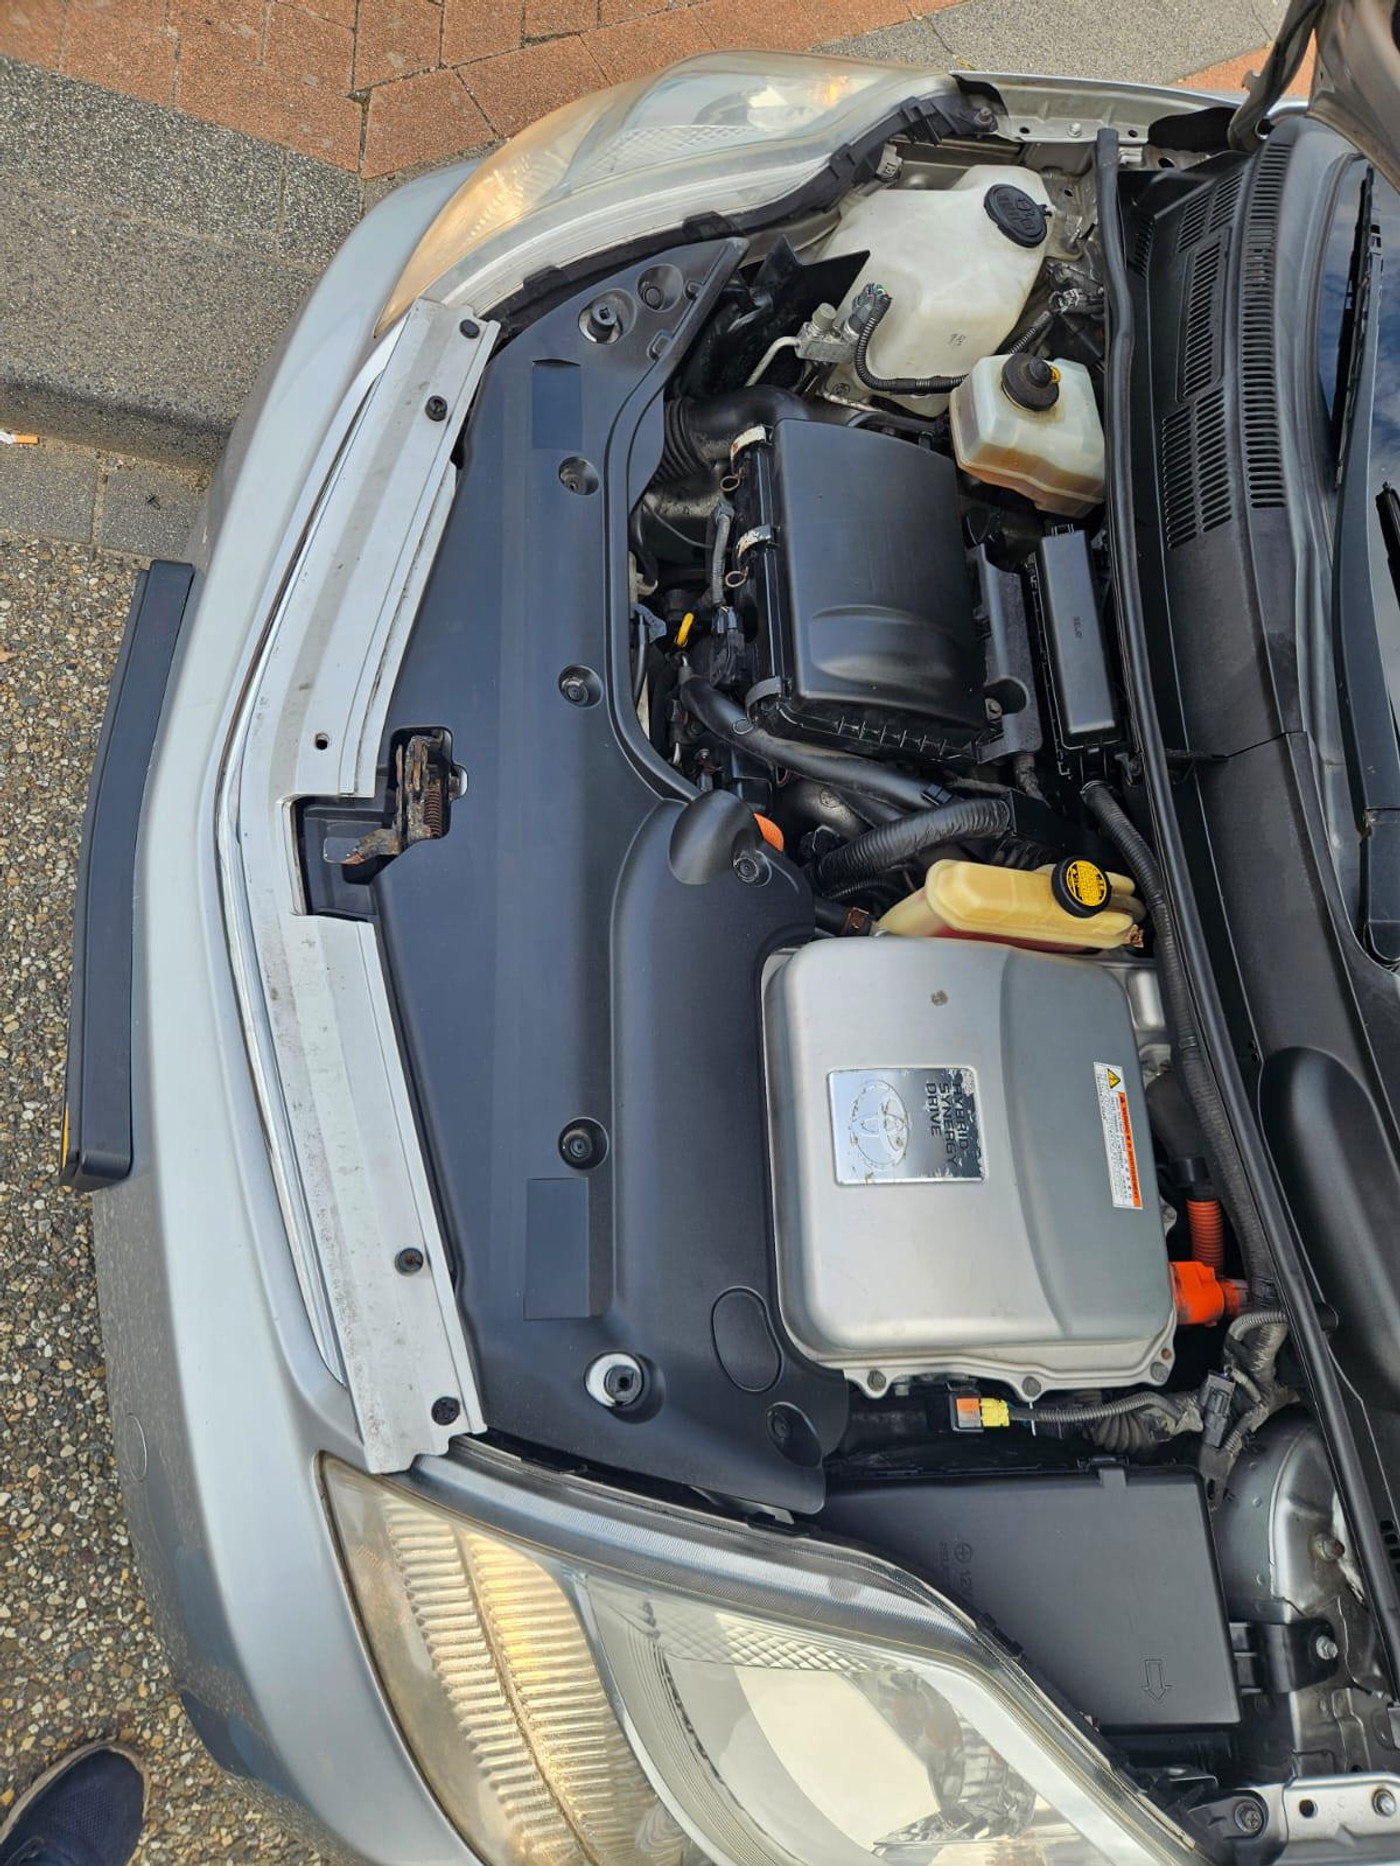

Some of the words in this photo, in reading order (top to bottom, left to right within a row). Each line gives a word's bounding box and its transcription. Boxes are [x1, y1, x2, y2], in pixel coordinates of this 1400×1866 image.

[926, 1083, 942, 1137] DRIVE
[939, 1083, 958, 1167] SYNERGY
[953, 1083, 969, 1150] HYBRID
